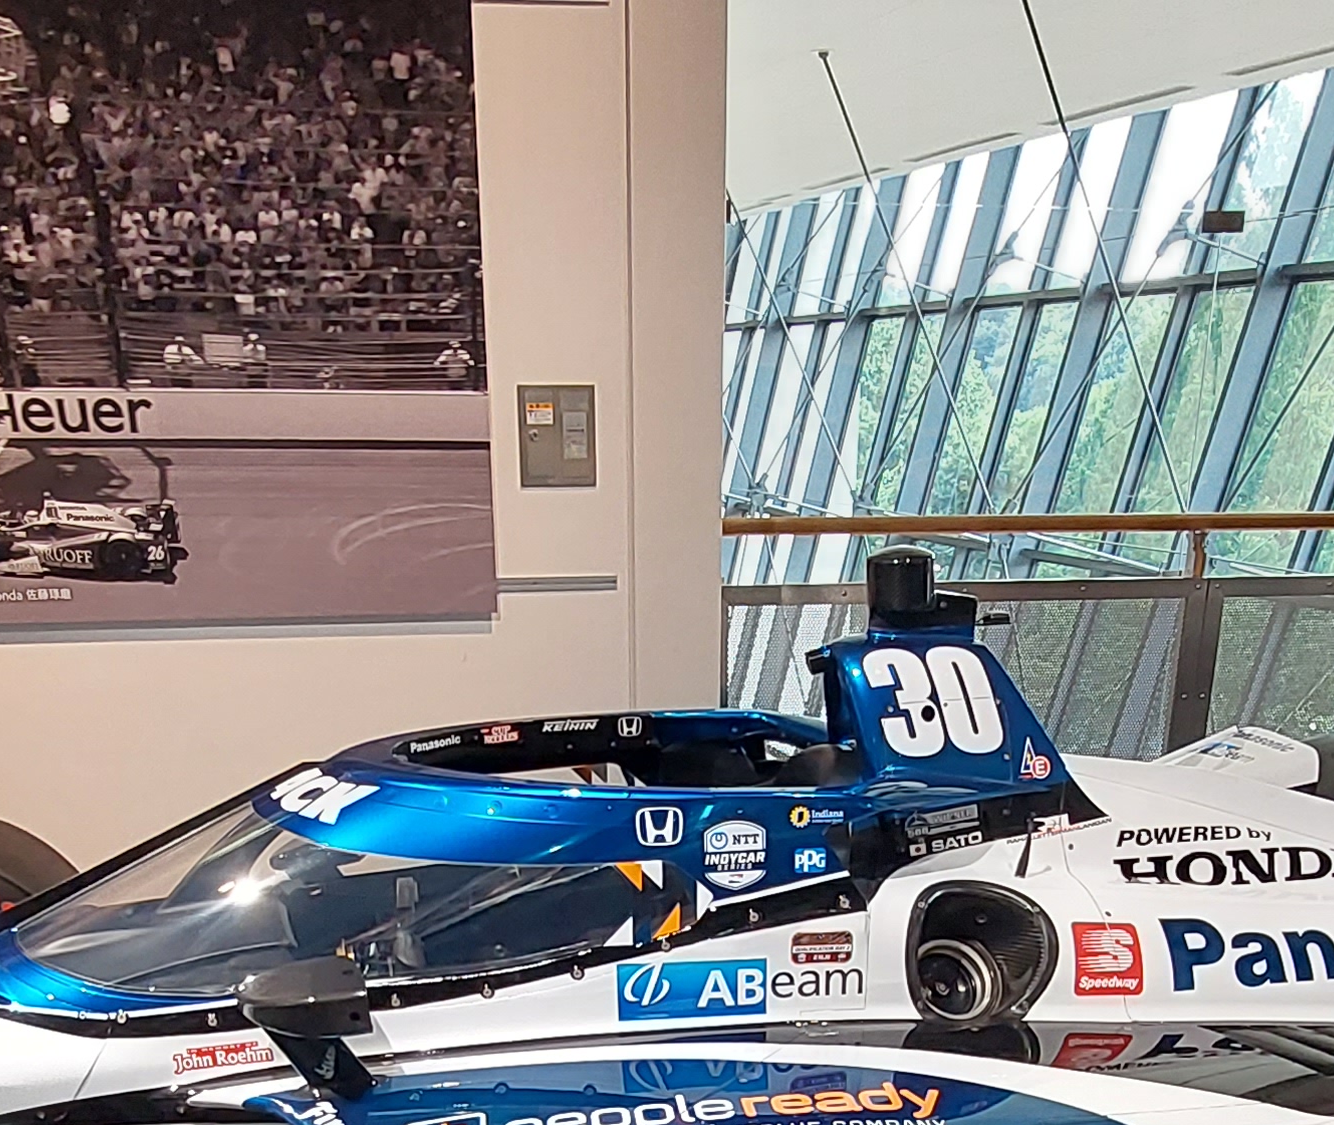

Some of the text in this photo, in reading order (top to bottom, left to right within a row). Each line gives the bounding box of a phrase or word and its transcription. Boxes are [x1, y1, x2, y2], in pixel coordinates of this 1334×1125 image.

[66, 513, 115, 522] Panasonic
[147, 544, 166, 561] 26
[864, 645, 1004, 757] 30
[542, 719, 599, 733] KEIHIN
[410, 734, 462, 754] Panasonic
[811, 809, 845, 818] Indiana
[732, 834, 760, 845] NTT
[931, 830, 983, 853] SATO
[1117, 826, 1273, 848] POWERED by
[704, 851, 766, 866] INDYCAR
[794, 849, 827, 873] PPG
[696, 966, 864, 1008] ABeam
[1077, 974, 1141, 993] Speedway
[174, 1048, 273, 1074] John Roehm
